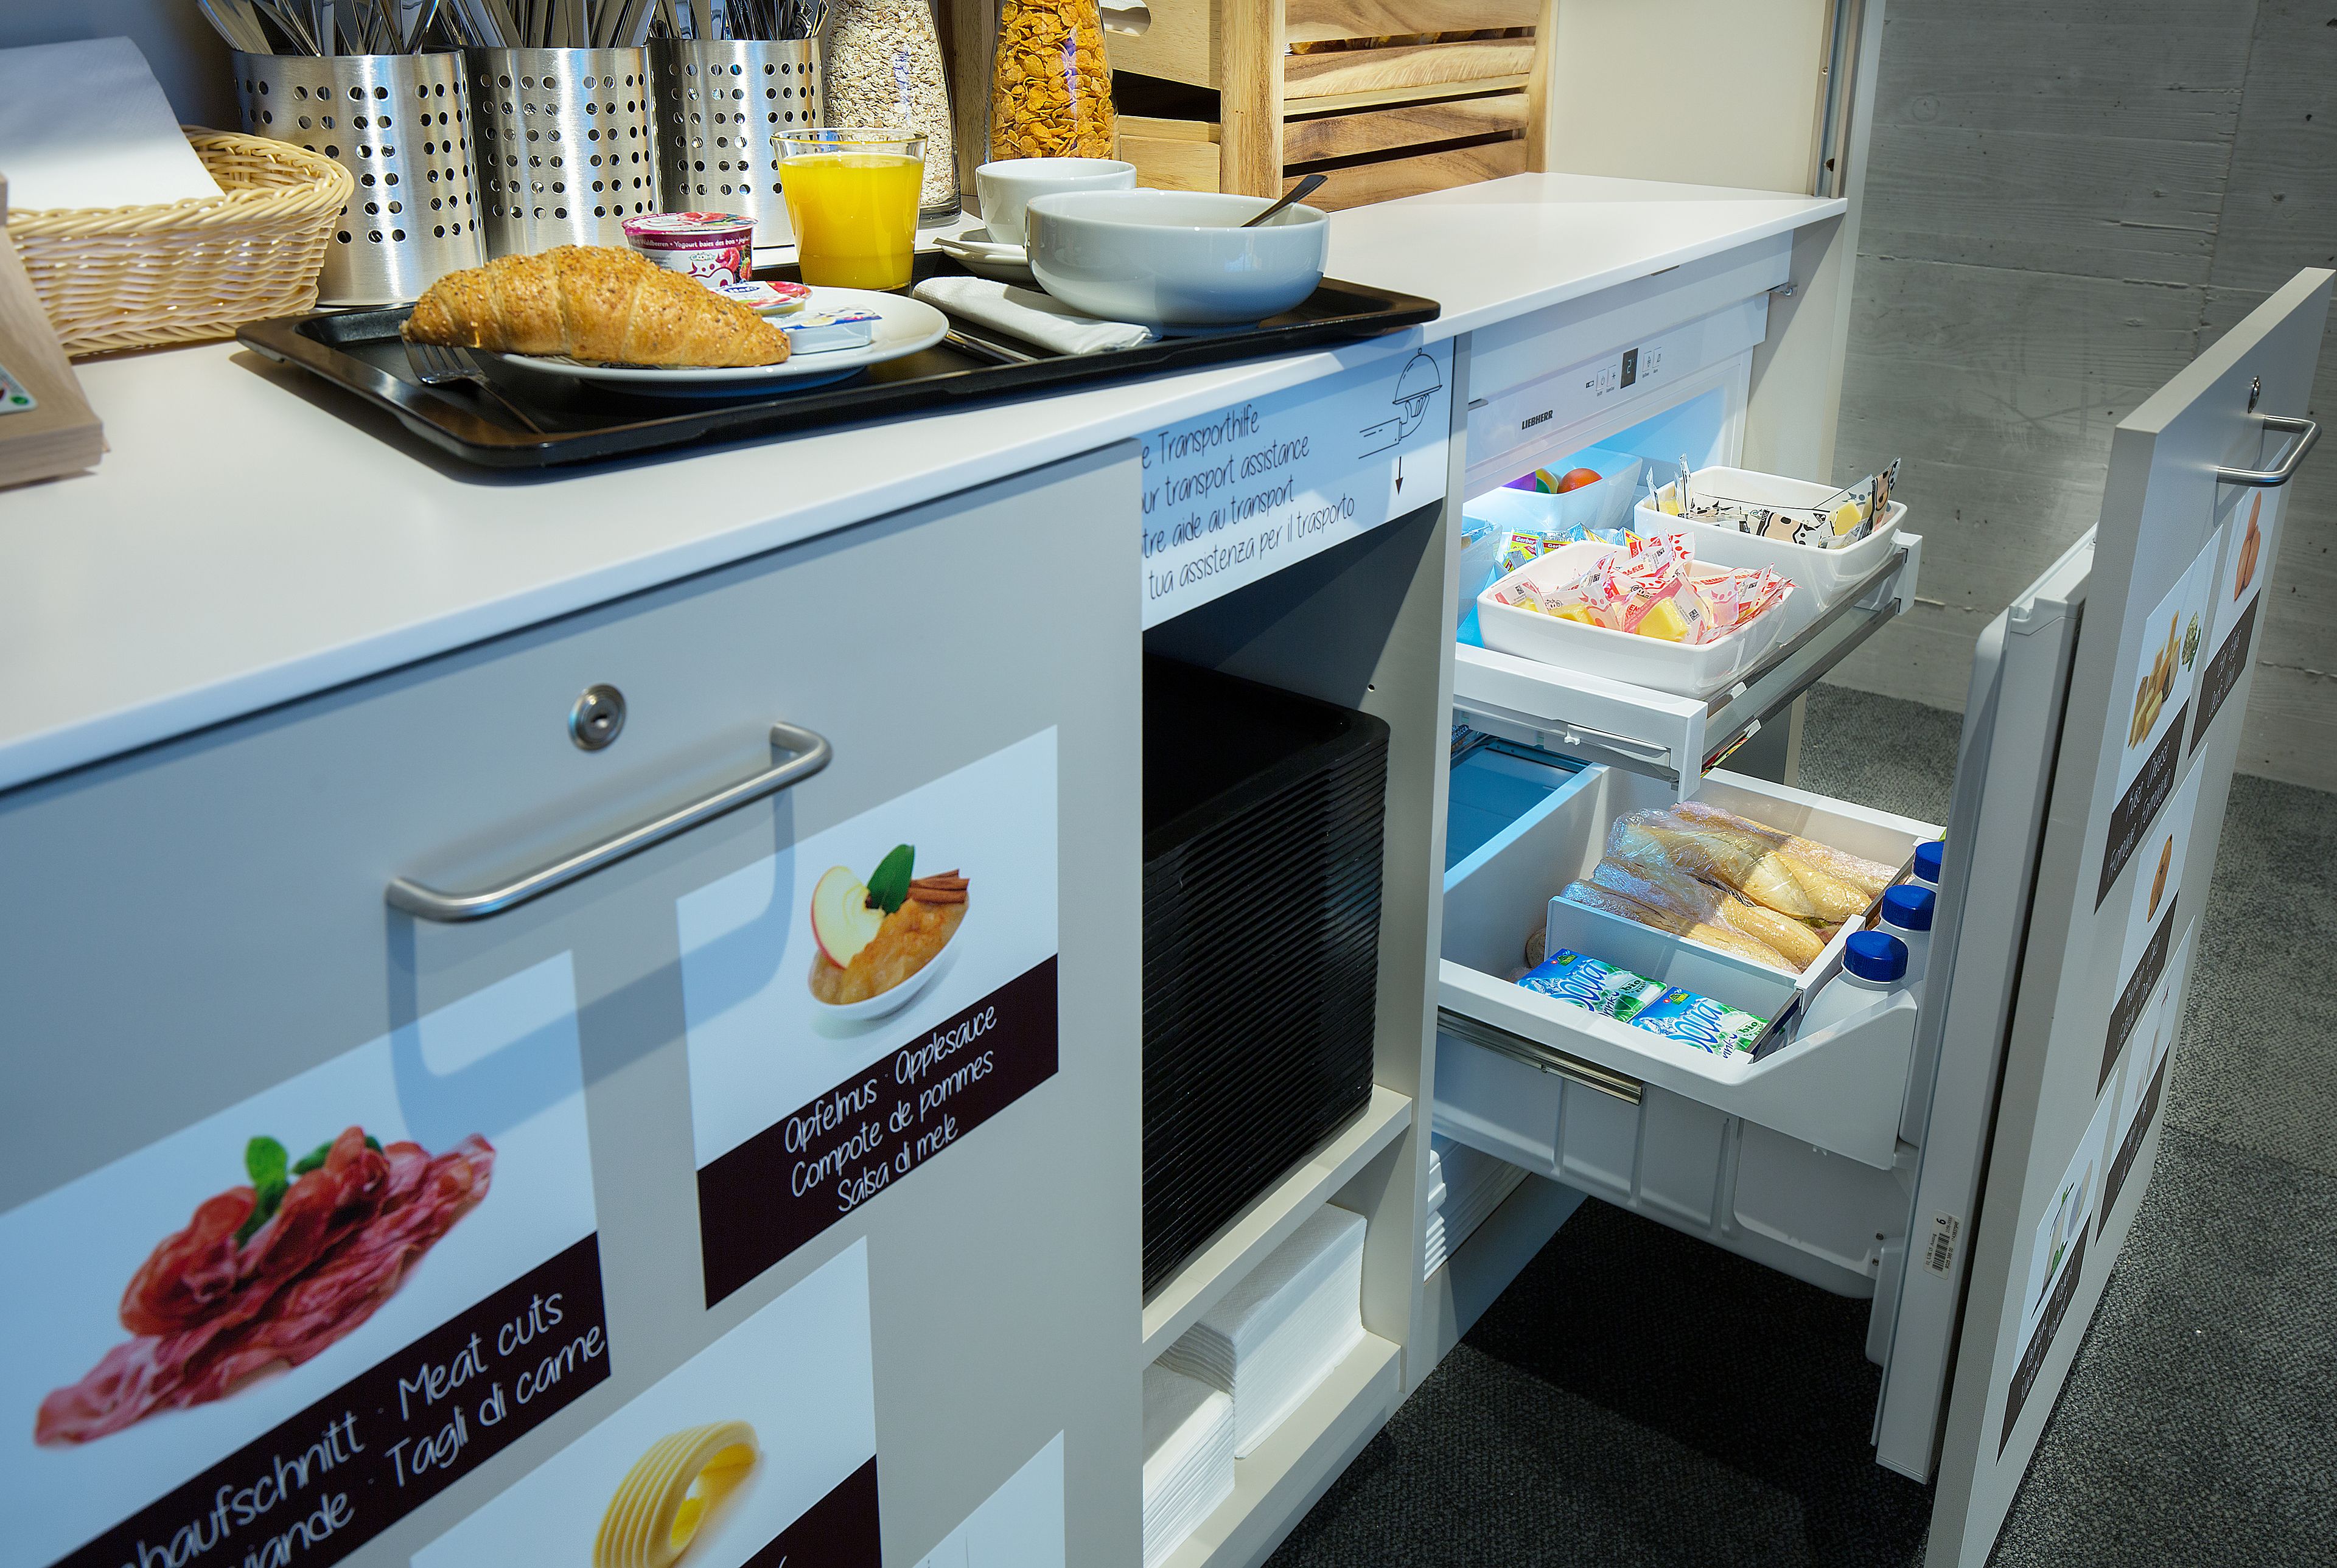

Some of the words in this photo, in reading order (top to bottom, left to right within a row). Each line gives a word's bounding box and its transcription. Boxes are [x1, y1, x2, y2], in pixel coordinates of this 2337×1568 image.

[1627, 359, 1632, 374] 2
[1158, 404, 1260, 465] Transporthilfe
[1521, 409, 1553, 430] LIEBHERR
[1142, 488, 1160, 514] ur
[1165, 462, 1235, 506] transport
[1241, 435, 1310, 479] assistance
[1172, 512, 1203, 543] aide
[1208, 508, 1226, 533] au
[1231, 475, 1294, 526] transport
[1515, 536, 1535, 545] Gerber
[1149, 571, 1174, 601] tua
[1179, 535, 1254, 589] assistenza
[1259, 524, 1283, 560] per
[1286, 518, 1293, 543] il
[1296, 493, 1356, 538] trasporto
[2147, 740, 2170, 789] Cheese
[2107, 823, 2137, 883] Fromage
[1620, 980, 1641, 991] bio
[1738, 1022, 1758, 1033] bio
[784, 1078, 878, 1154] Apfelmus
[895, 1005, 997, 1086] Applesauce
[791, 1120, 882, 1198] Compote
[889, 1099, 913, 1134] de
[920, 1050, 995, 1123] pommes
[838, 1161, 889, 1212] Salsa
[895, 1143, 910, 1174] di
[917, 1113, 958, 1162] mele
[398, 1332, 489, 1421] Meat
[498, 1291, 565, 1357] cuts
[385, 1406, 470, 1486] Tagli
[479, 1381, 509, 1427] di
[515, 1324, 606, 1403] carne
